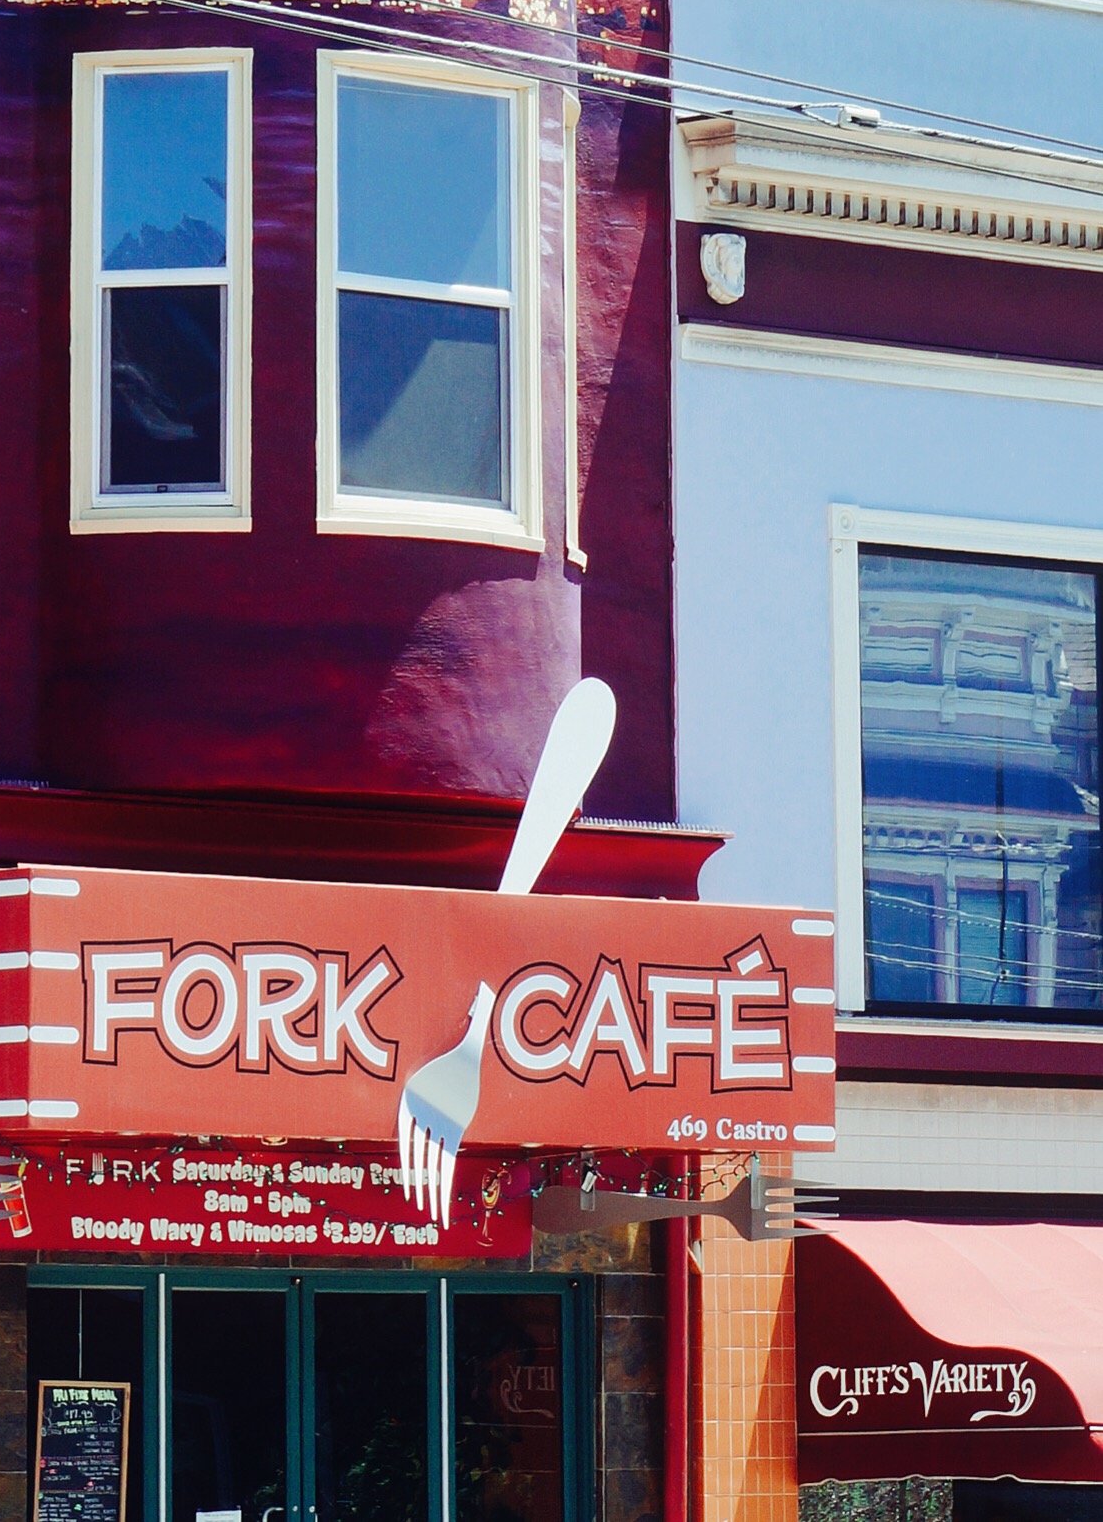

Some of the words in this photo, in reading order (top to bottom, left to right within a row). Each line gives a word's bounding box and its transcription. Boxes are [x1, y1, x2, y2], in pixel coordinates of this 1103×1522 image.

[82, 938, 403, 1079] FORK
[491, 935, 792, 1092] CAFÉ
[667, 1115, 708, 1141] 469
[716, 1118, 788, 1141] Castro
[172, 1158, 263, 1187] Saturday
[289, 1161, 364, 1189] Sunday
[370, 1163, 440, 1186] Bru
[204, 1190, 248, 1212] 8am
[268, 1191, 311, 1217] 5pm
[71, 1216, 144, 1245] Bloody
[150, 1218, 204, 1246] Mary
[210, 1222, 222, 1242] &
[228, 1220, 318, 1243] Mimosas
[810, 1365, 909, 1417] CLIFF'S
[909, 1359, 1036, 1422] VARIETY
